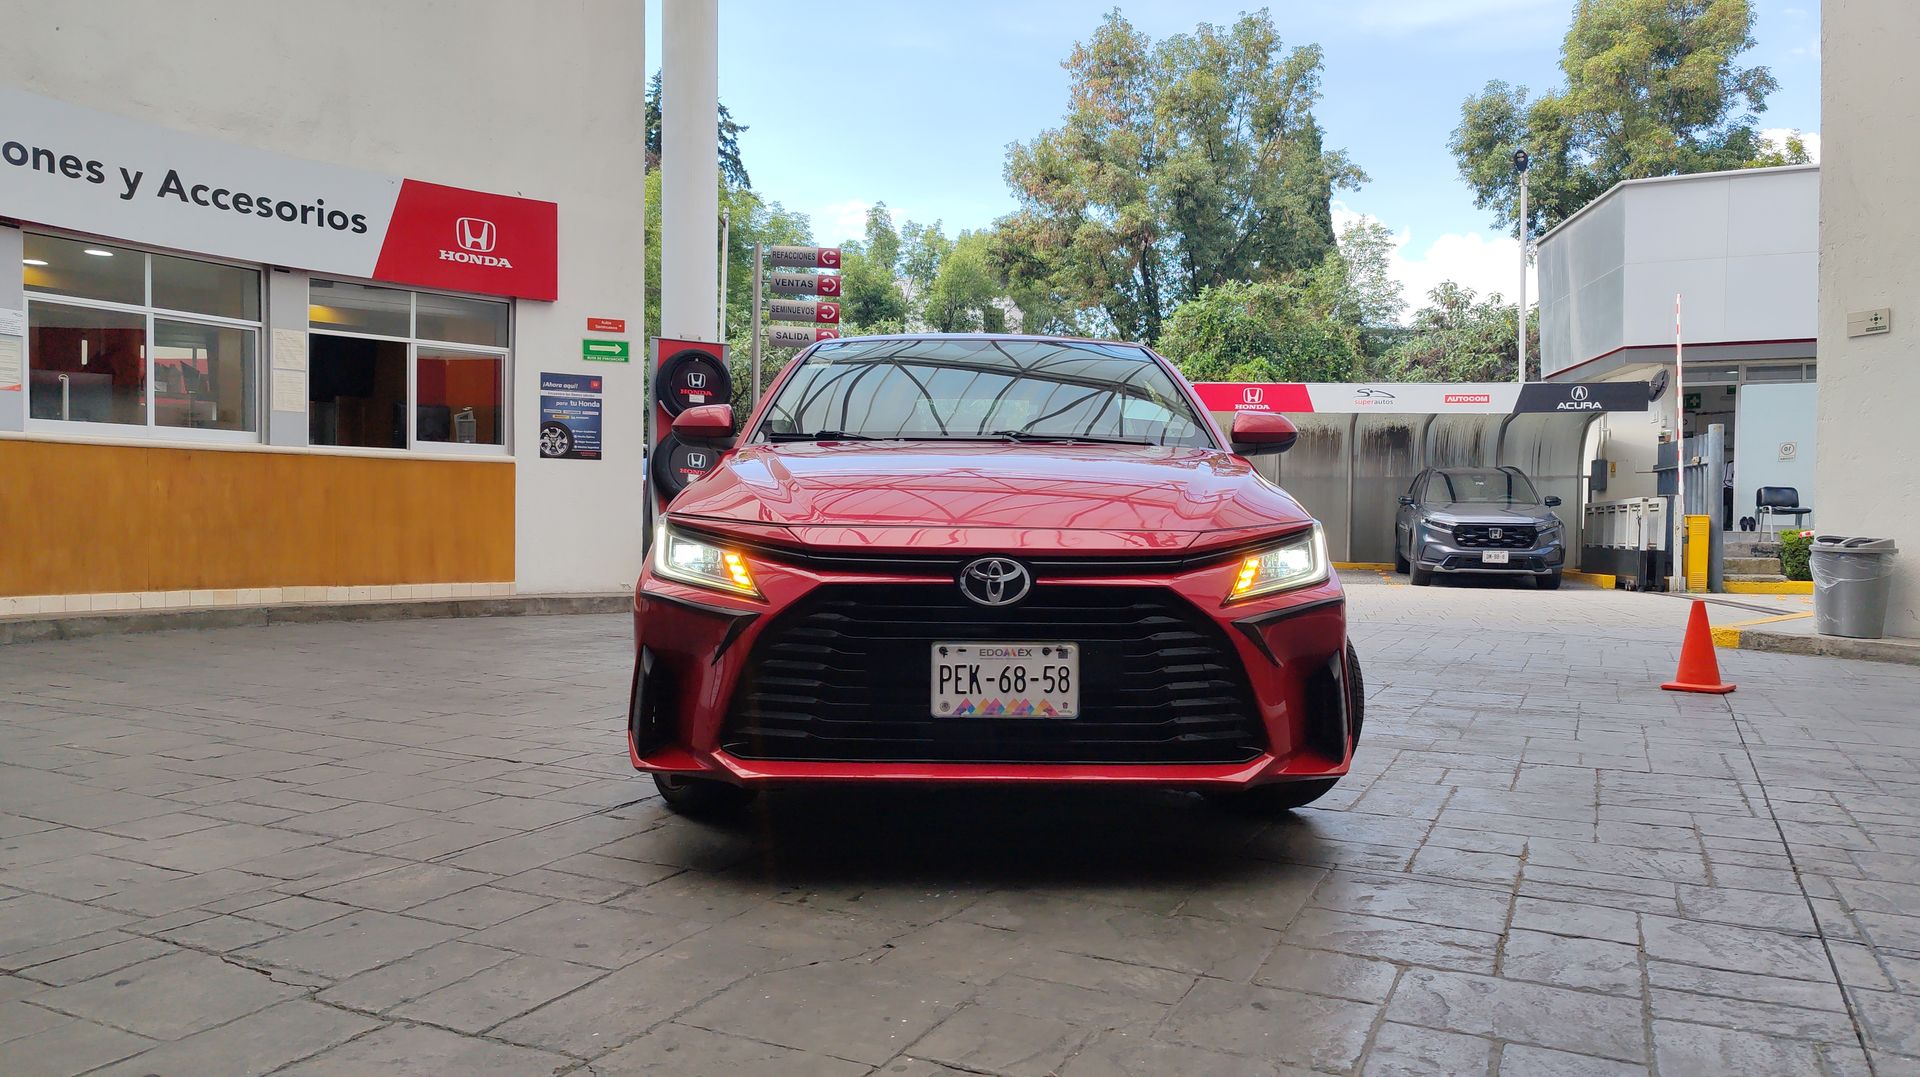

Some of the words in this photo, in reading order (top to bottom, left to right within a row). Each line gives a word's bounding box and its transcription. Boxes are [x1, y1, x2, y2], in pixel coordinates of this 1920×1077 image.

[119, 166, 143, 201] y
[157, 169, 368, 234] Accesorios
[438, 249, 513, 269] HONDA
[772, 250, 816, 261] REFACCIONES
[774, 278, 814, 288] VENTAS
[771, 304, 815, 315] SEMINUEVOS
[775, 331, 810, 341] SALIDA
[680, 388, 713, 397] HONDA
[578, 400, 601, 408] Honda
[1556, 401, 1603, 410] ACURA
[679, 467, 706, 475] HON
[939, 664, 1070, 695] PEK-68-58
